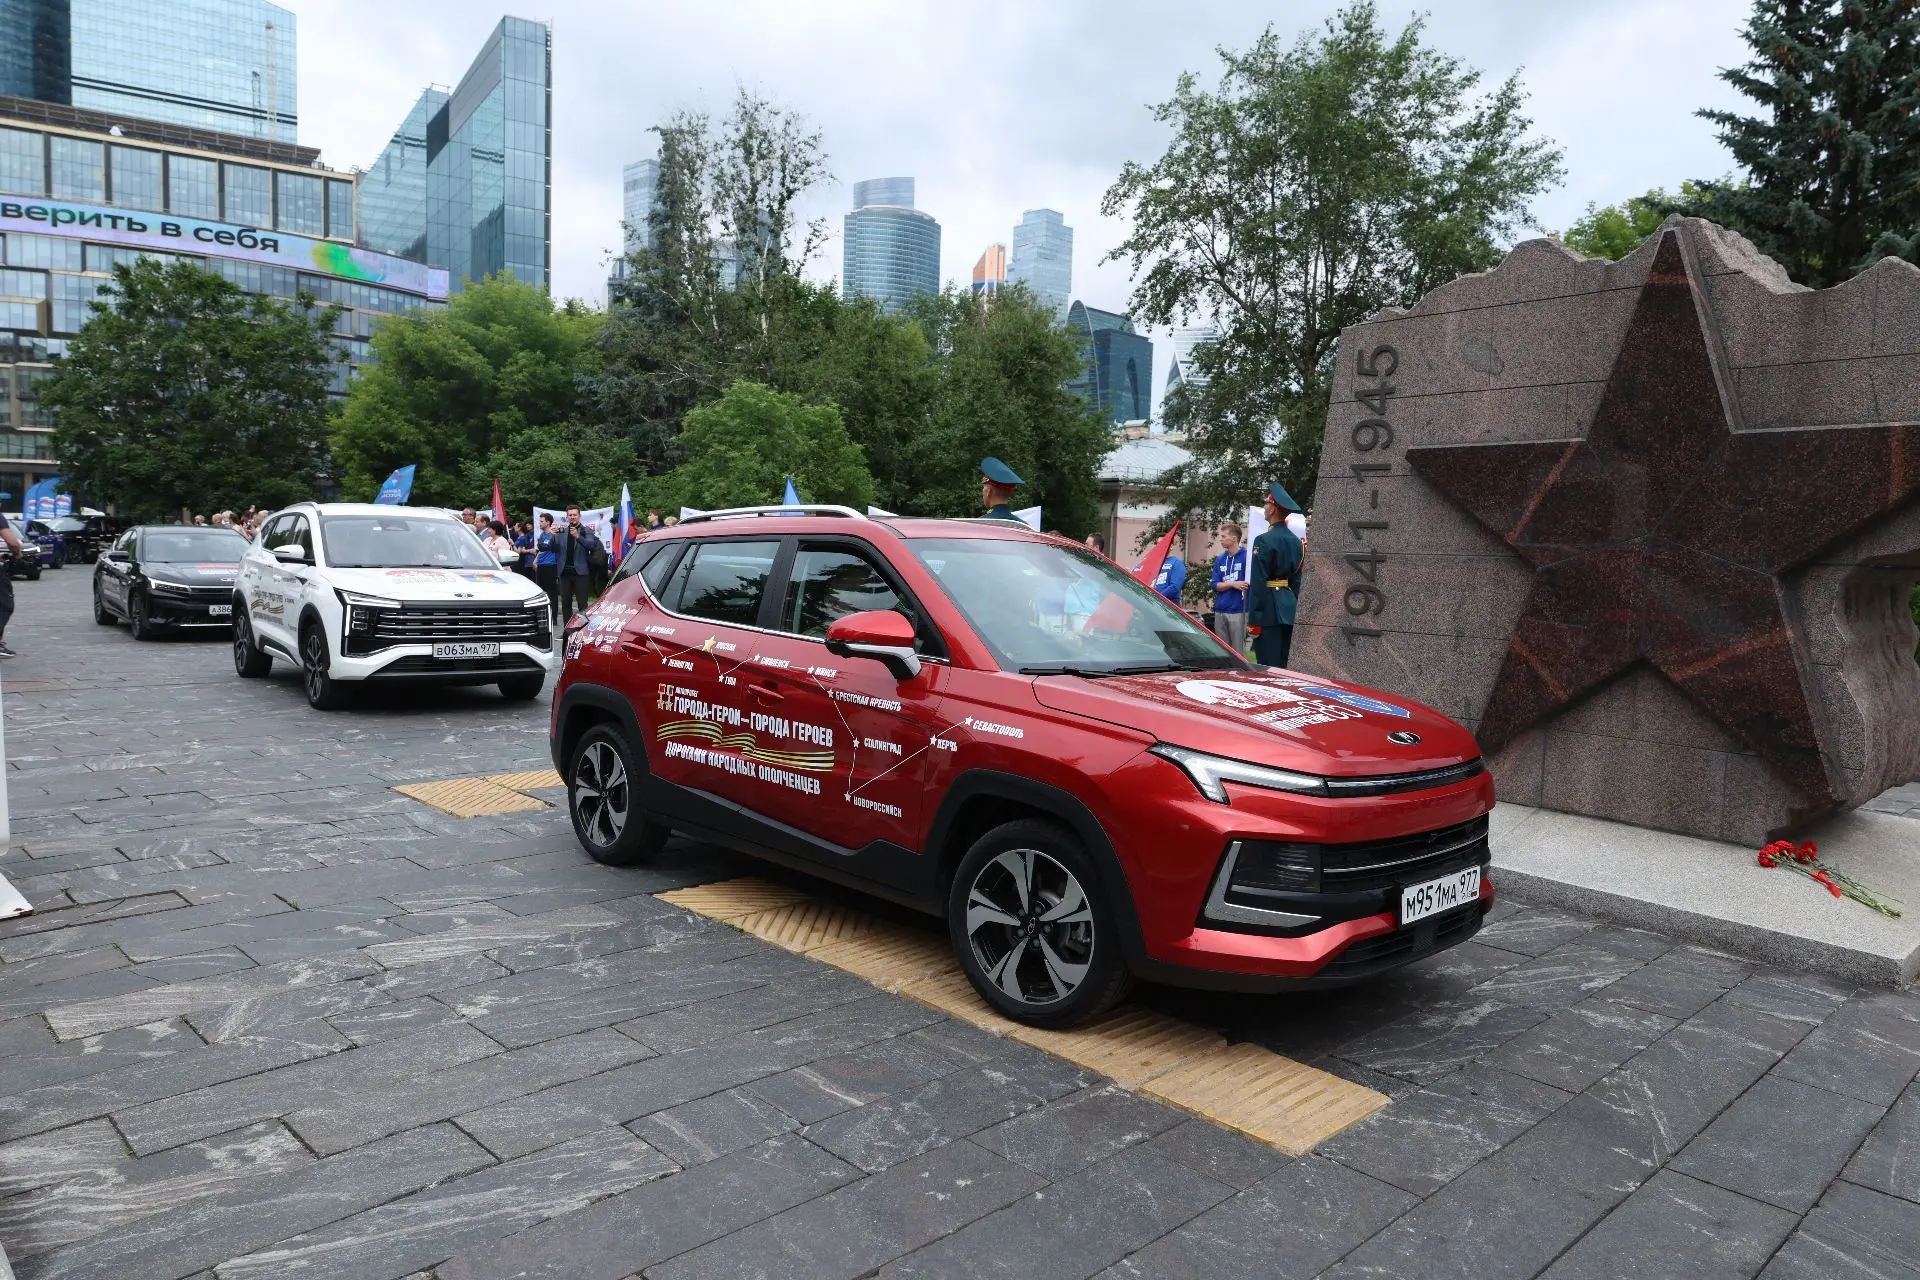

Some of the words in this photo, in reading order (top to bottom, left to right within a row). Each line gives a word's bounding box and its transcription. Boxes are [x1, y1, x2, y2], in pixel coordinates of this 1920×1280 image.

[1, 203, 148, 233] верить
[161, 219, 182, 237] в
[193, 226, 280, 254] себя
[1342, 344, 1399, 646] 1941-1945
[480, 643, 497, 652] 977
[750, 711, 790, 739] ГОРОДА
[792, 720, 833, 748] ГЕРОЕВ
[863, 737, 902, 757] СТАЛИНГРАД
[972, 719, 1025, 739] СЕВАСТОПОЛЬ
[665, 740, 708, 765] ДОРОГАМИ
[708, 751, 757, 778] НАРОДНЫХ
[758, 764, 821, 795] ОПОЛЧЕНЦЕВ
[853, 795, 902, 818] НОВОРОССИЙСК
[1406, 881, 1458, 919] М951МА
[1460, 869, 1478, 893] 977
